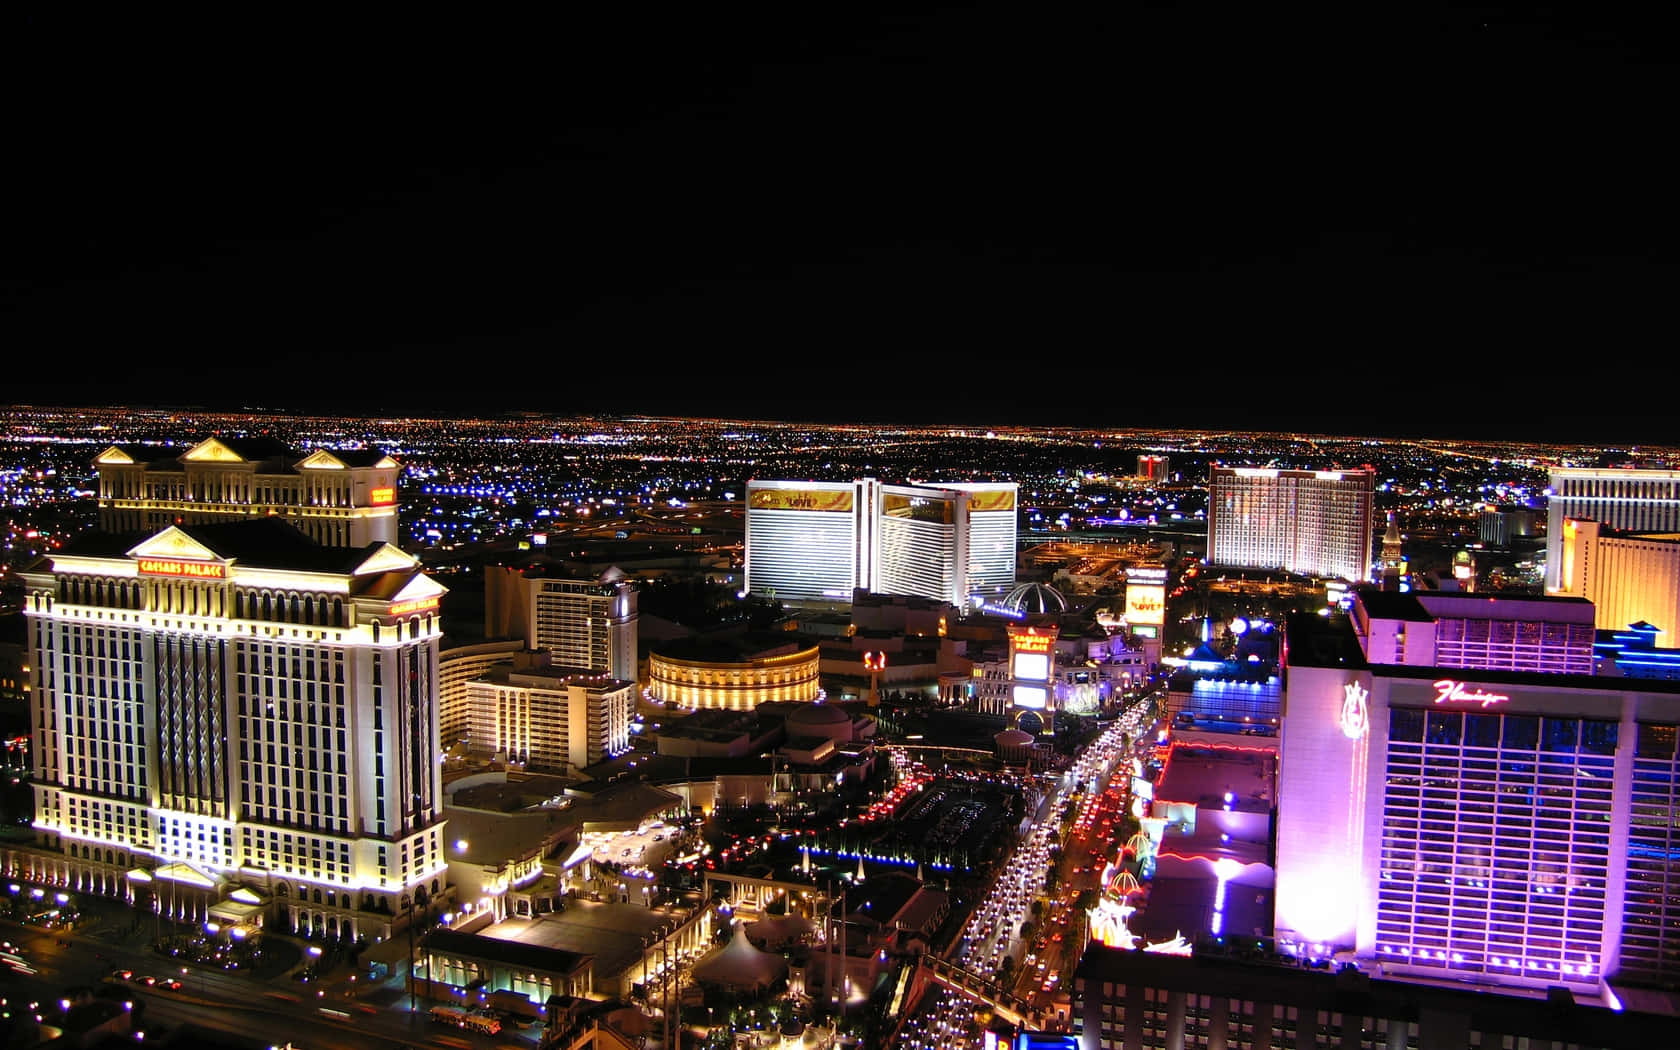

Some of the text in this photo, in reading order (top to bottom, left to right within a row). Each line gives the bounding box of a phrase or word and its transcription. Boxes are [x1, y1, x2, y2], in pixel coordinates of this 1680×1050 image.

[141, 561, 221, 576] CAESARS PALACE
[1433, 680, 1509, 708] Flamingo
